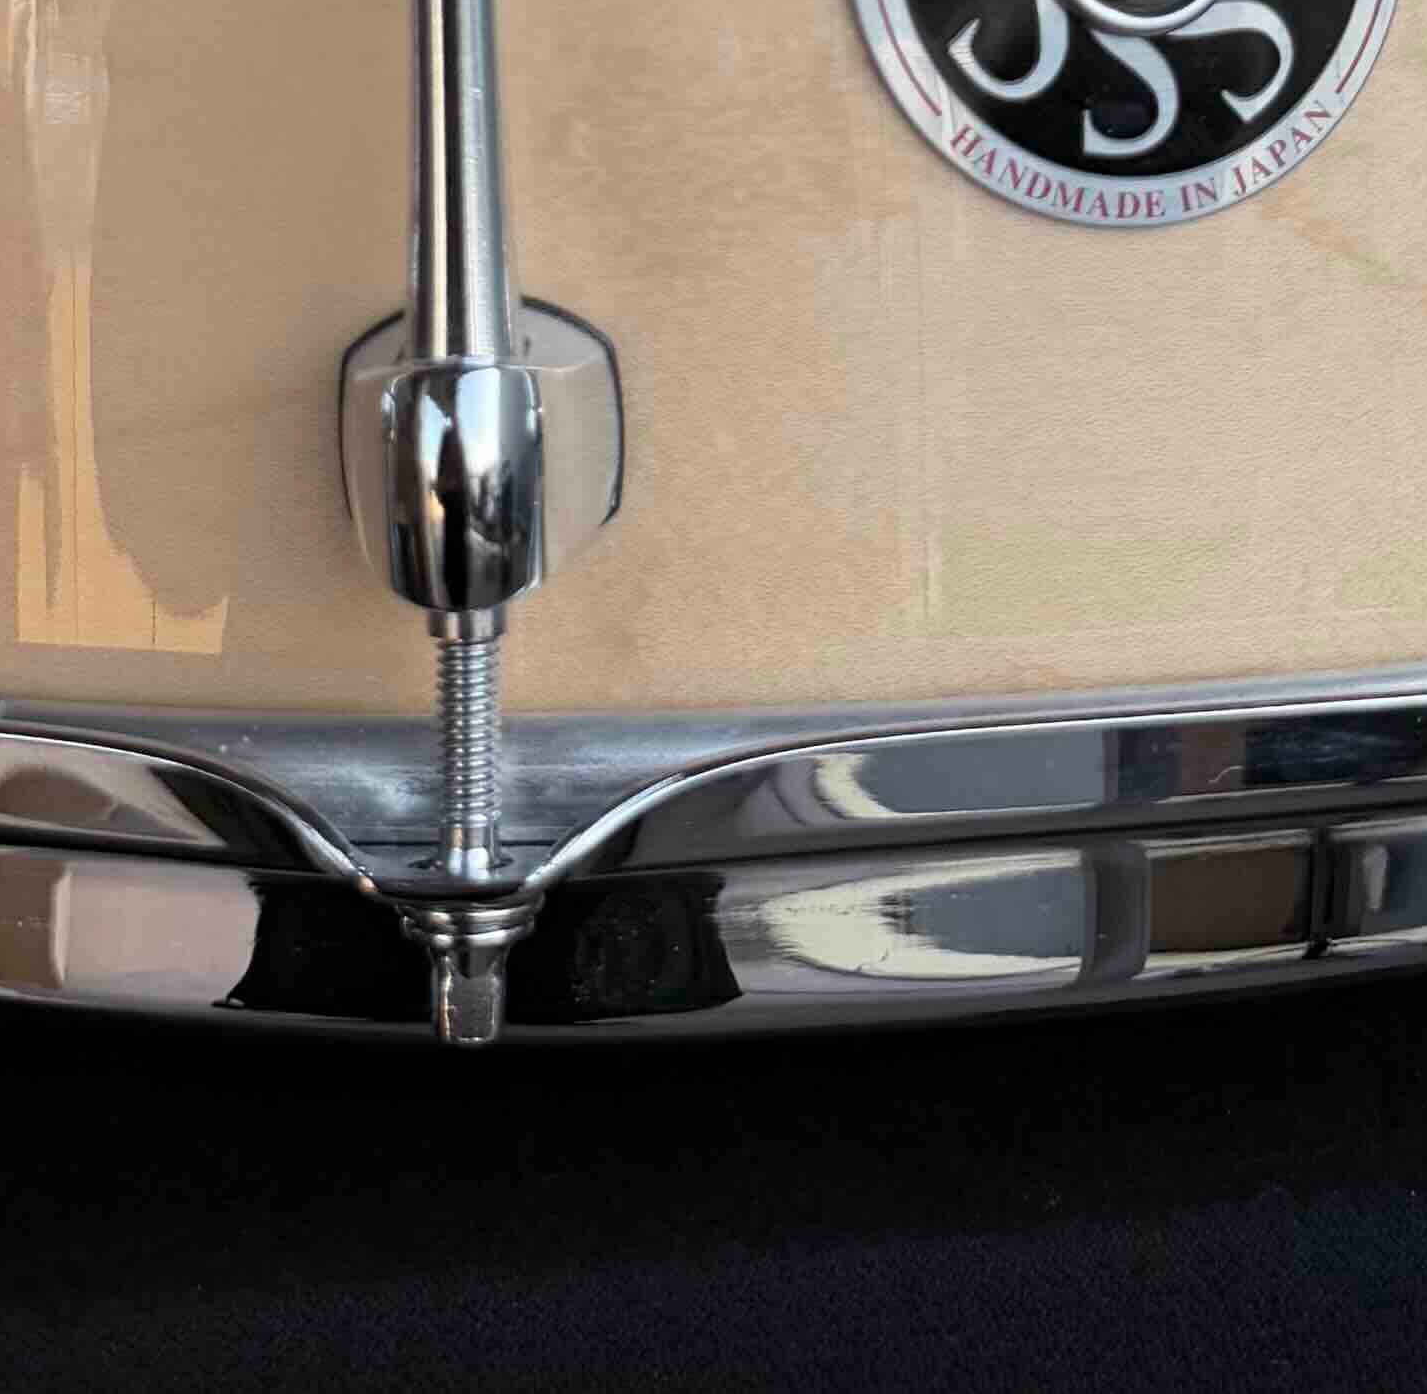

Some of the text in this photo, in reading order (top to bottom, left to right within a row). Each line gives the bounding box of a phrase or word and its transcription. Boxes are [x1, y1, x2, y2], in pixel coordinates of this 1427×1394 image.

[949, 100, 1333, 221] HANDMADE IN JAPAN
